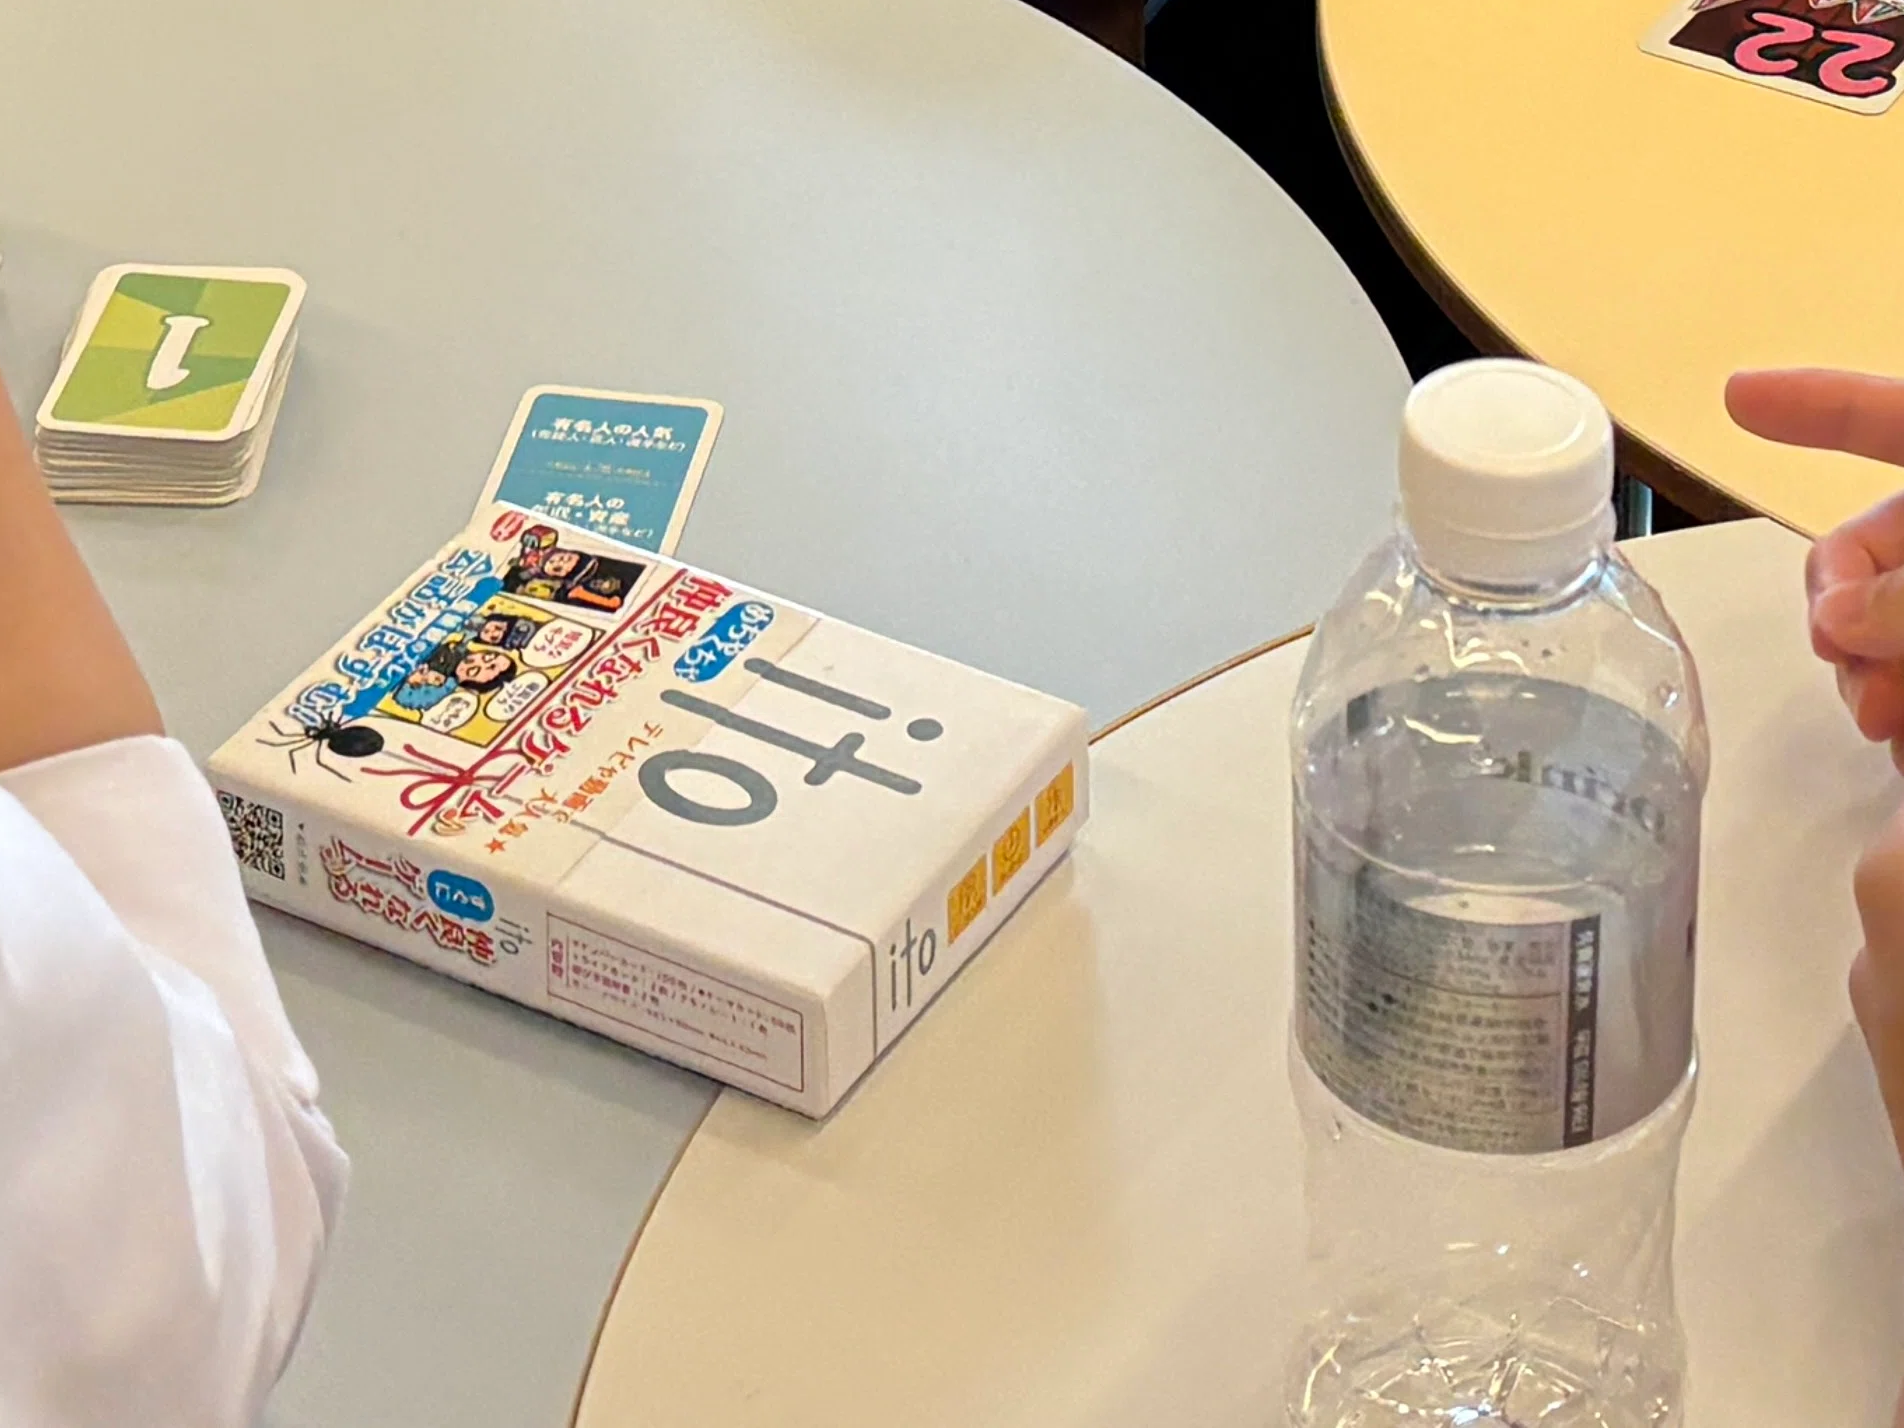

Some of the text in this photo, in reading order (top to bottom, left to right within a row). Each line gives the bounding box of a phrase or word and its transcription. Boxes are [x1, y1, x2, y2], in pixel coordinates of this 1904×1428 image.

[1733, 11, 1896, 96] 22
[145, 315, 210, 391] 1
[552, 417, 673, 441] 有名人の人気
[544, 490, 625, 510] 有名人の
[638, 657, 943, 827] ito
[495, 916, 533, 956] ito
[889, 917, 937, 1012] ito
